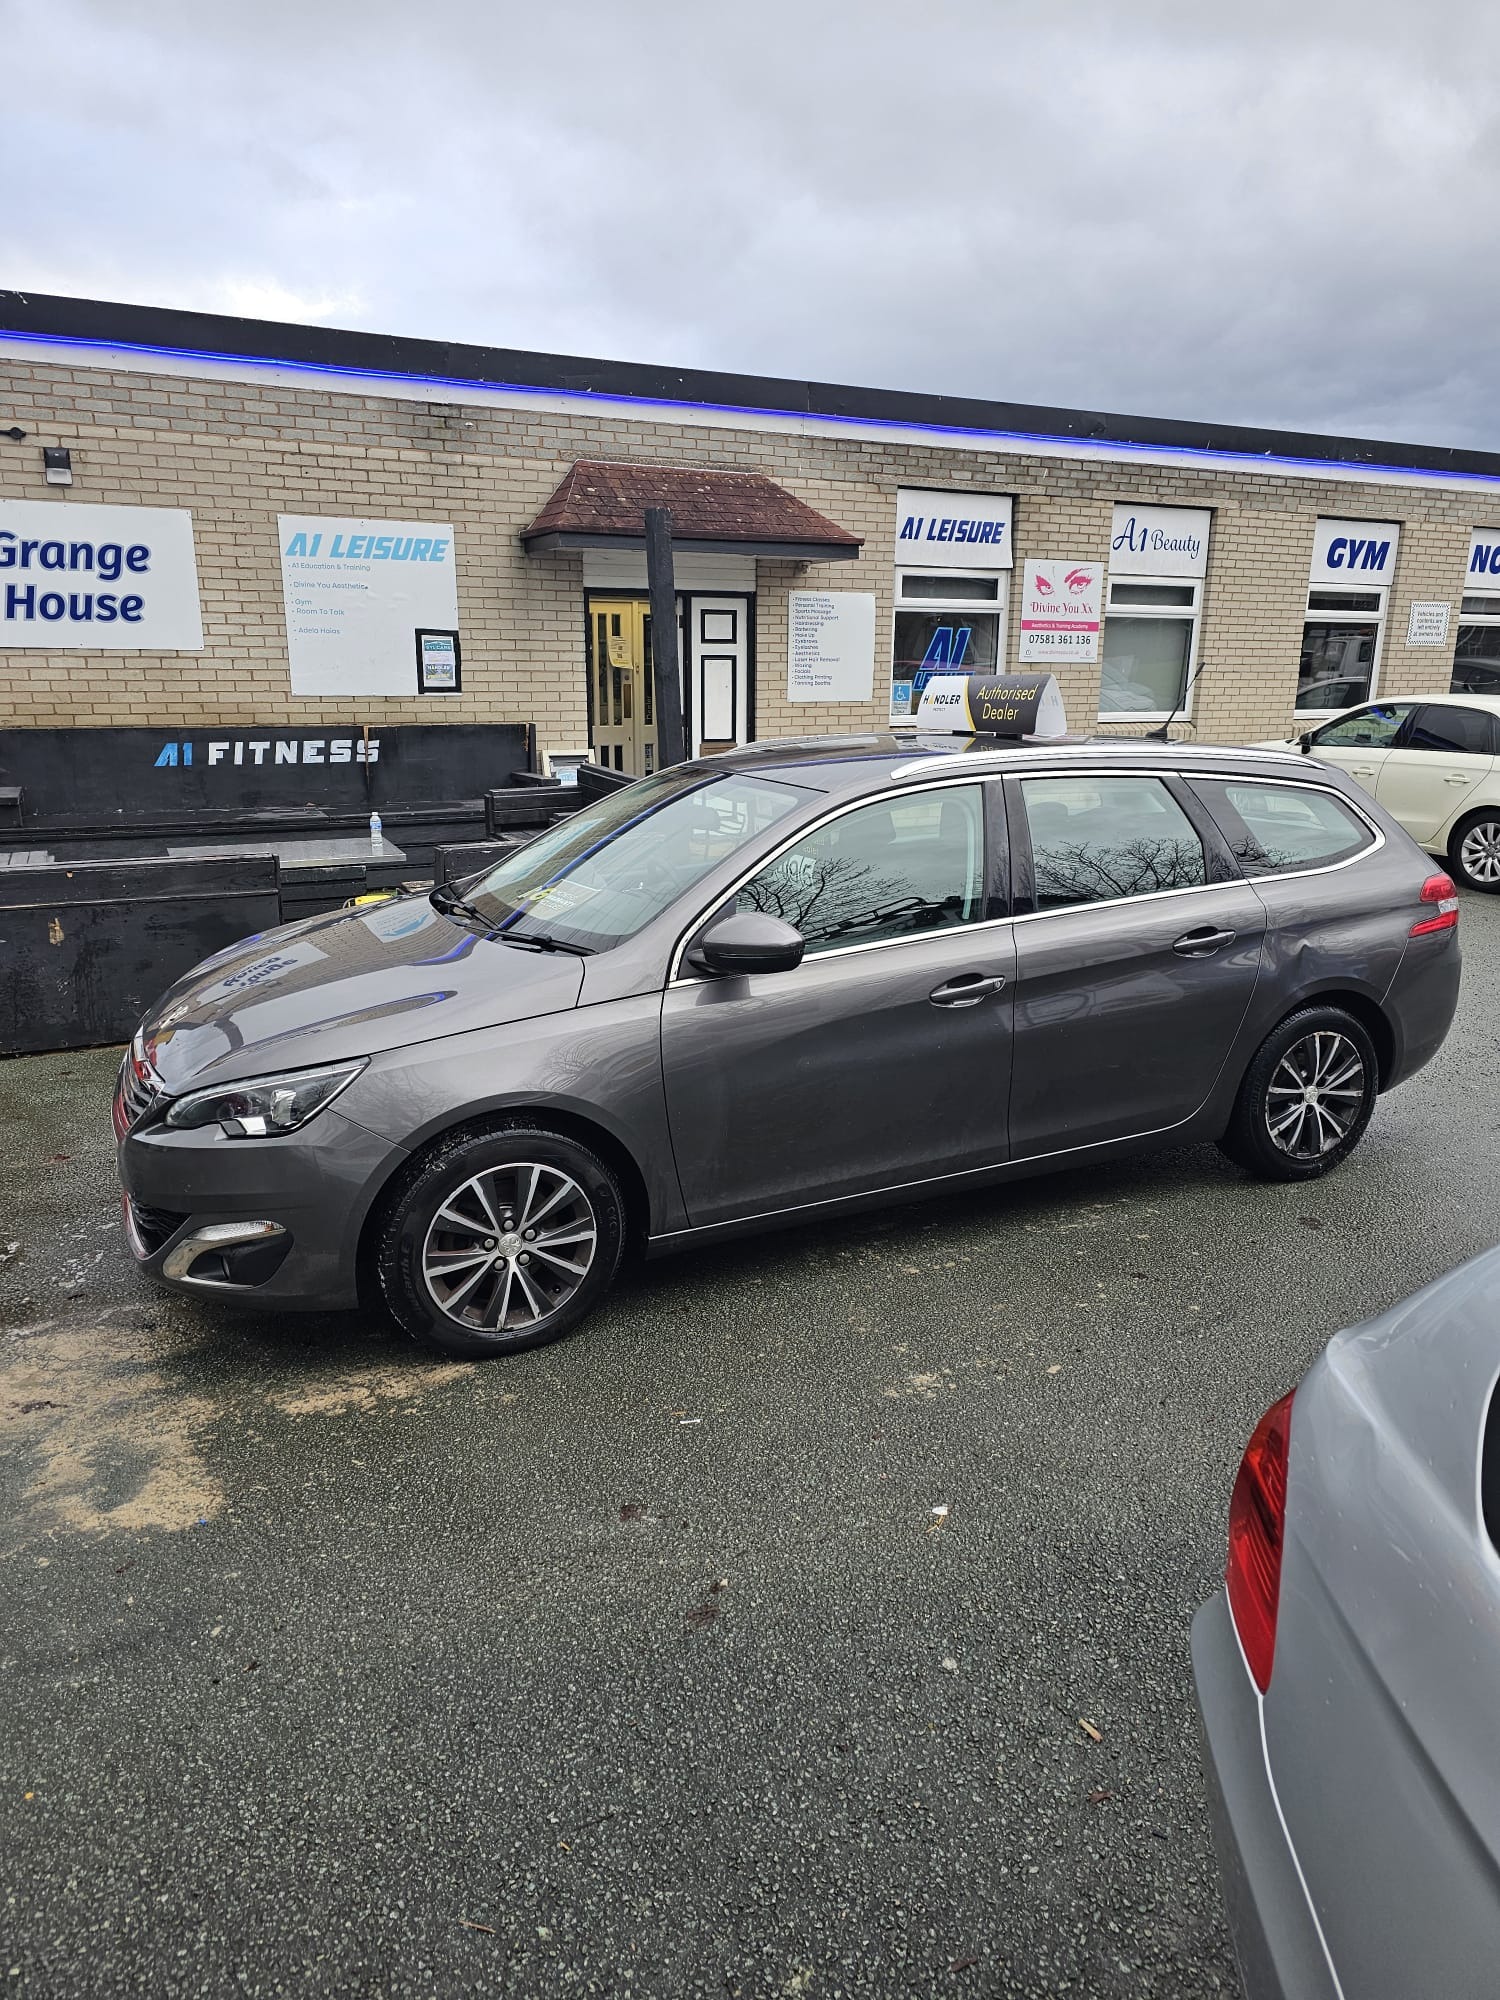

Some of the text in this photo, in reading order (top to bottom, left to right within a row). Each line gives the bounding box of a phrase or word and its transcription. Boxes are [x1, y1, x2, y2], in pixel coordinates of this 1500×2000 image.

[926, 518, 1005, 544] LEISURE
[1112, 517, 1201, 559] A1 Beauty
[0, 530, 151, 582] Grange
[285, 533, 450, 562] A1 LEISURE
[1327, 537, 1390, 570] GYM
[301, 562, 335, 570] Education
[343, 563, 371, 571] Training
[4, 583, 145, 623] House
[295, 598, 312, 606] Gym
[329, 608, 345, 616] Talk
[1030, 601, 1093, 616] Divine You Xx
[919, 627, 971, 670] A1
[1029, 634, 1091, 645] 07581 361 136
[923, 694, 961, 705] HANDLER
[976, 683, 1039, 700] Authorised
[982, 702, 1019, 720] Dealer
[154, 739, 380, 767] A1 FITNESS
